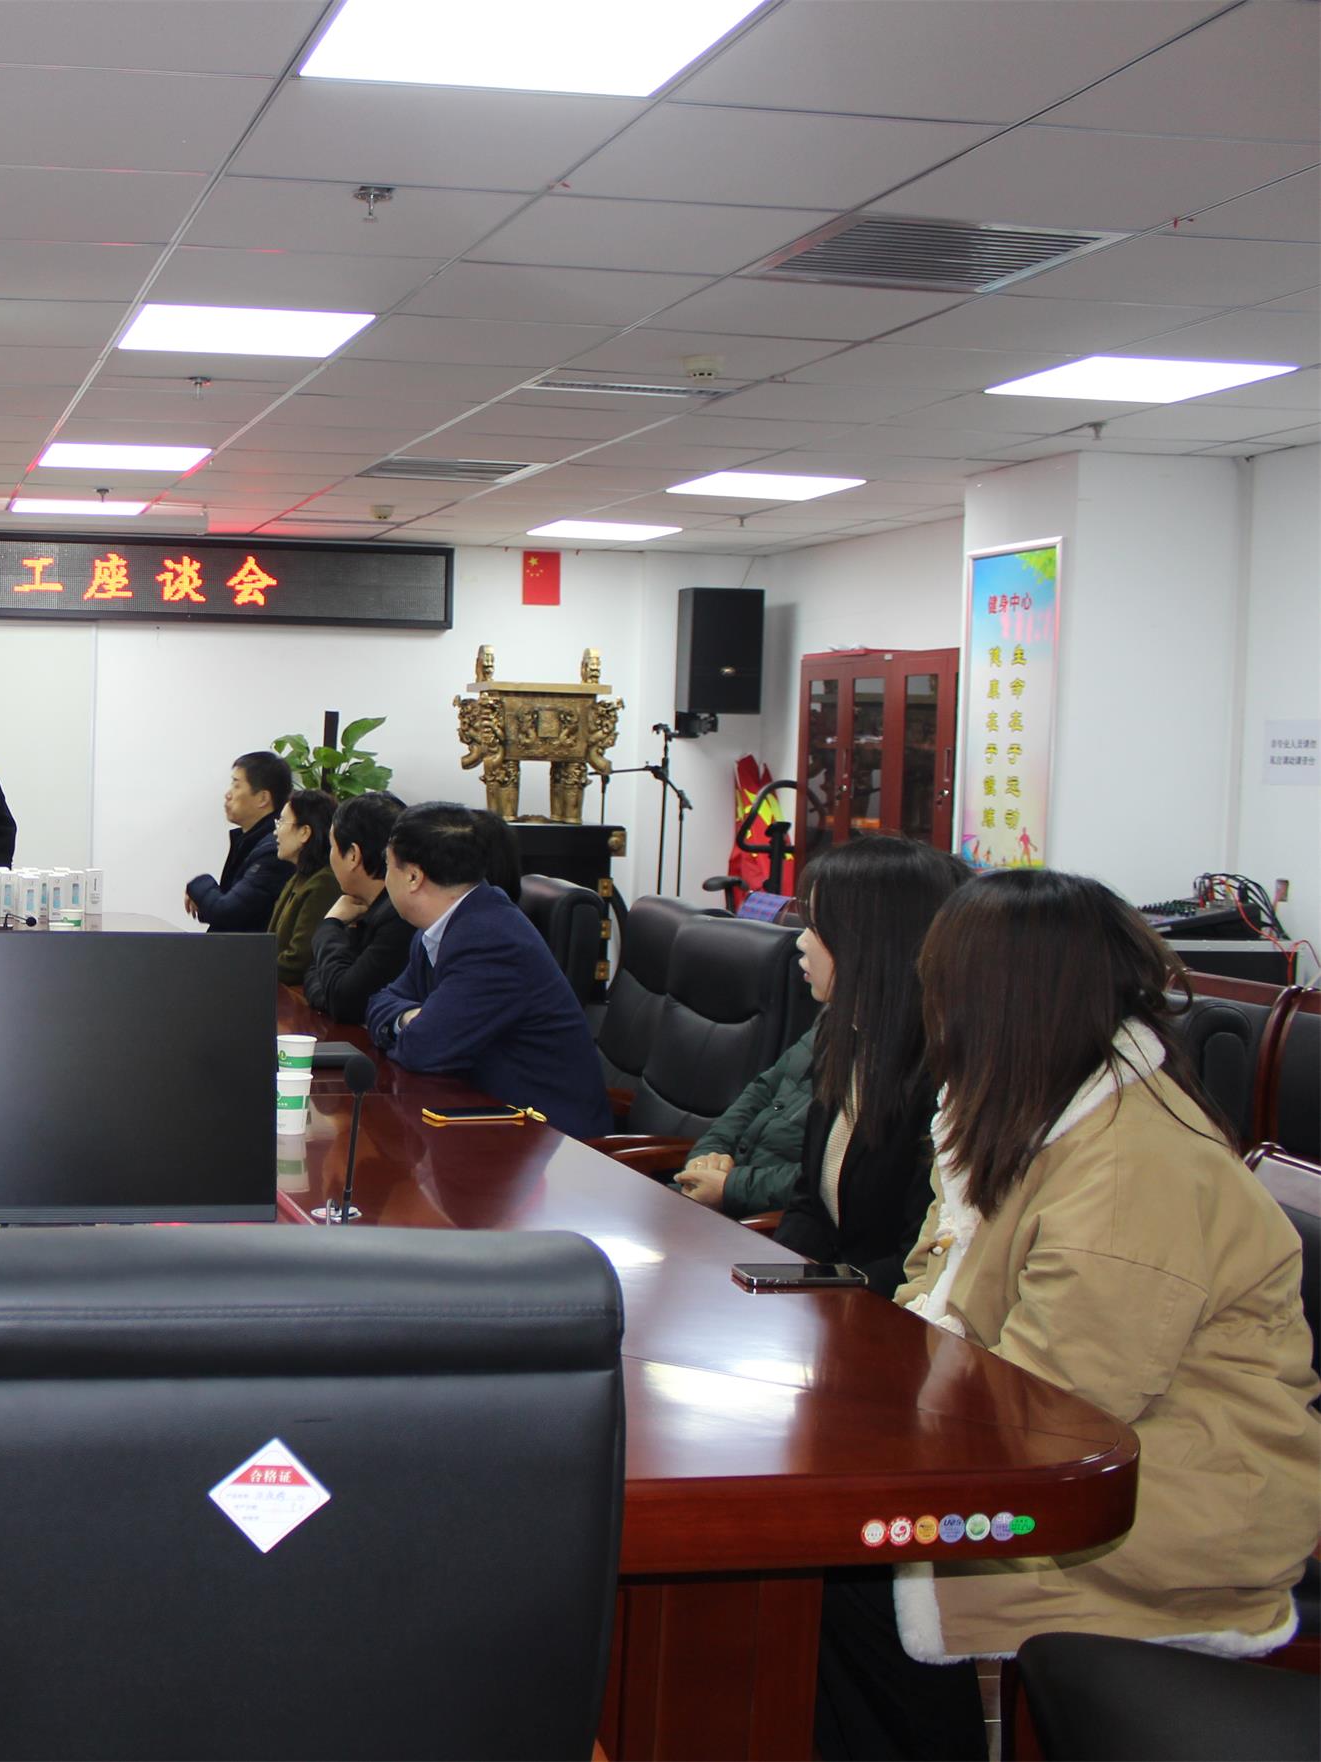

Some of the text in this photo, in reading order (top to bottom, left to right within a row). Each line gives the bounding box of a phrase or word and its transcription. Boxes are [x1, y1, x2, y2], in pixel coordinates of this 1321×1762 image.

[988, 593, 1031, 614] 健身中心
[1005, 644, 1027, 830] 生命在于运动
[250, 1469, 292, 1483] 合格证
